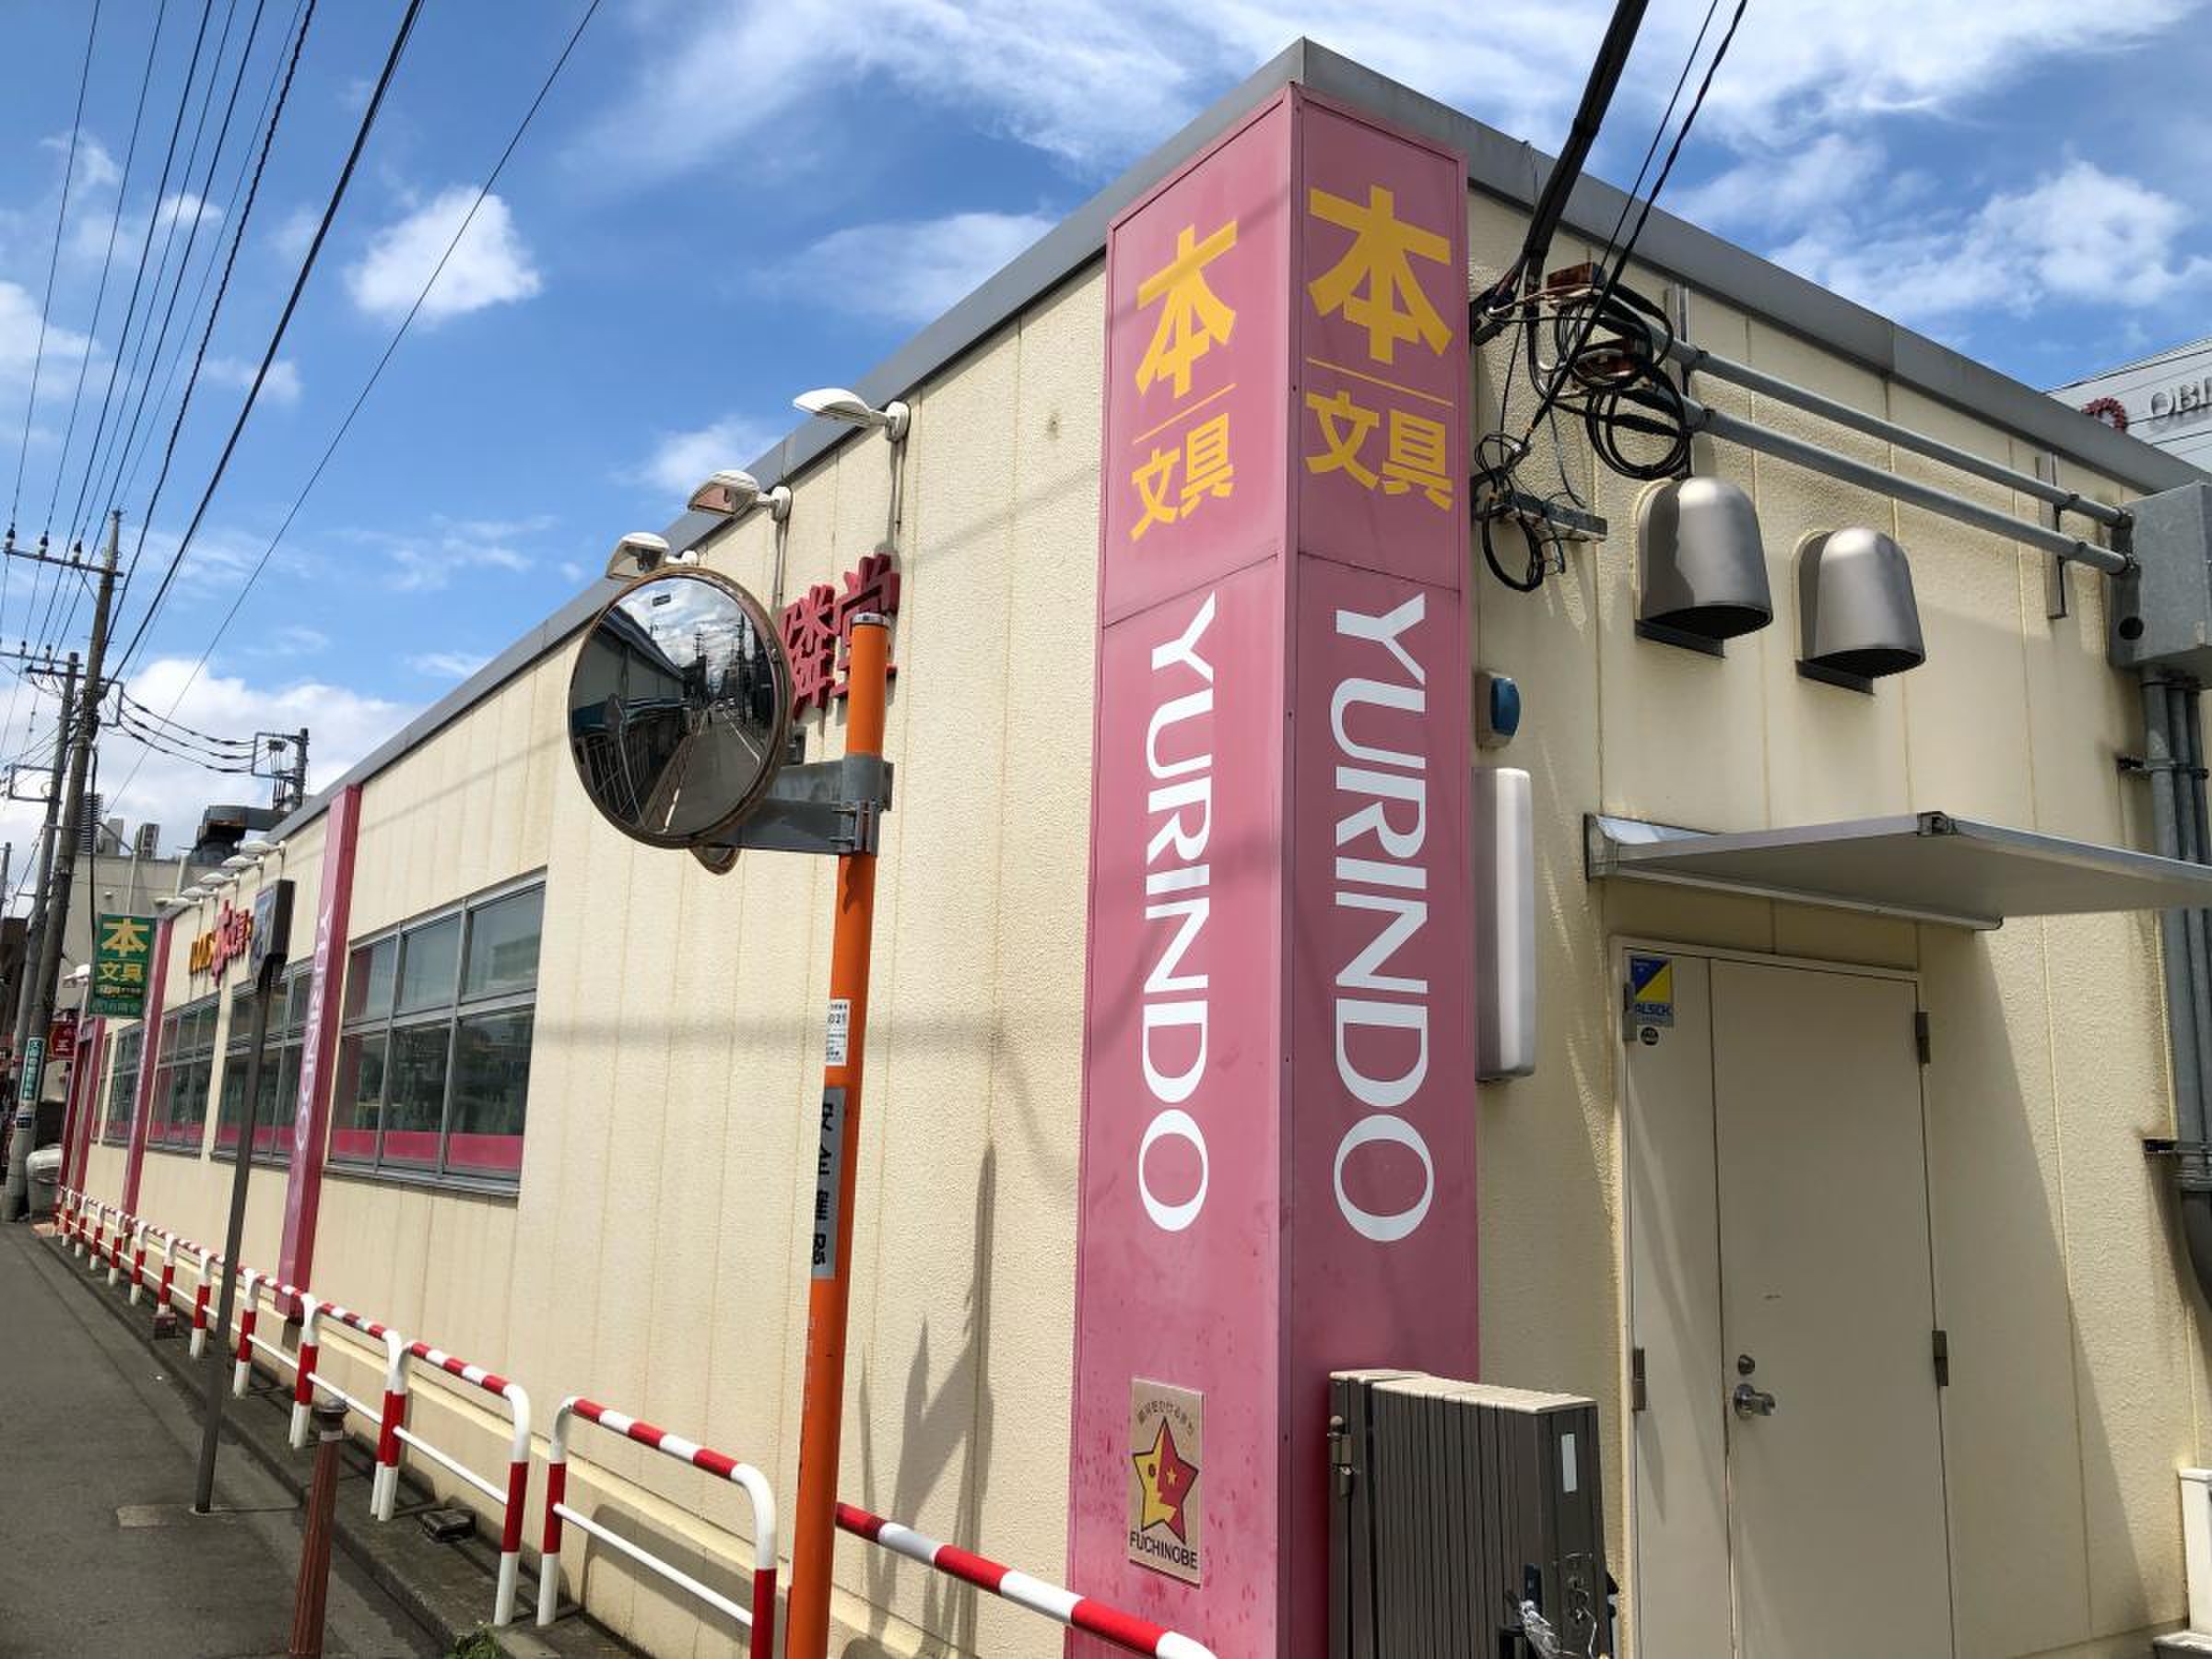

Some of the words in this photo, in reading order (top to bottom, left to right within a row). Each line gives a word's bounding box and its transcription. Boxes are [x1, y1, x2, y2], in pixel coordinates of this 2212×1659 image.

[1135, 220, 1238, 398] 本
[1309, 184, 1453, 364] 本
[1129, 411, 1235, 543] 文具
[1305, 390, 1454, 512] 文具
[100, 917, 150, 959] 本
[1138, 592, 1215, 1231] YURINDO
[1331, 592, 1434, 1241] YURINDO
[1130, 1532, 1197, 1570] FUCHINOBE
